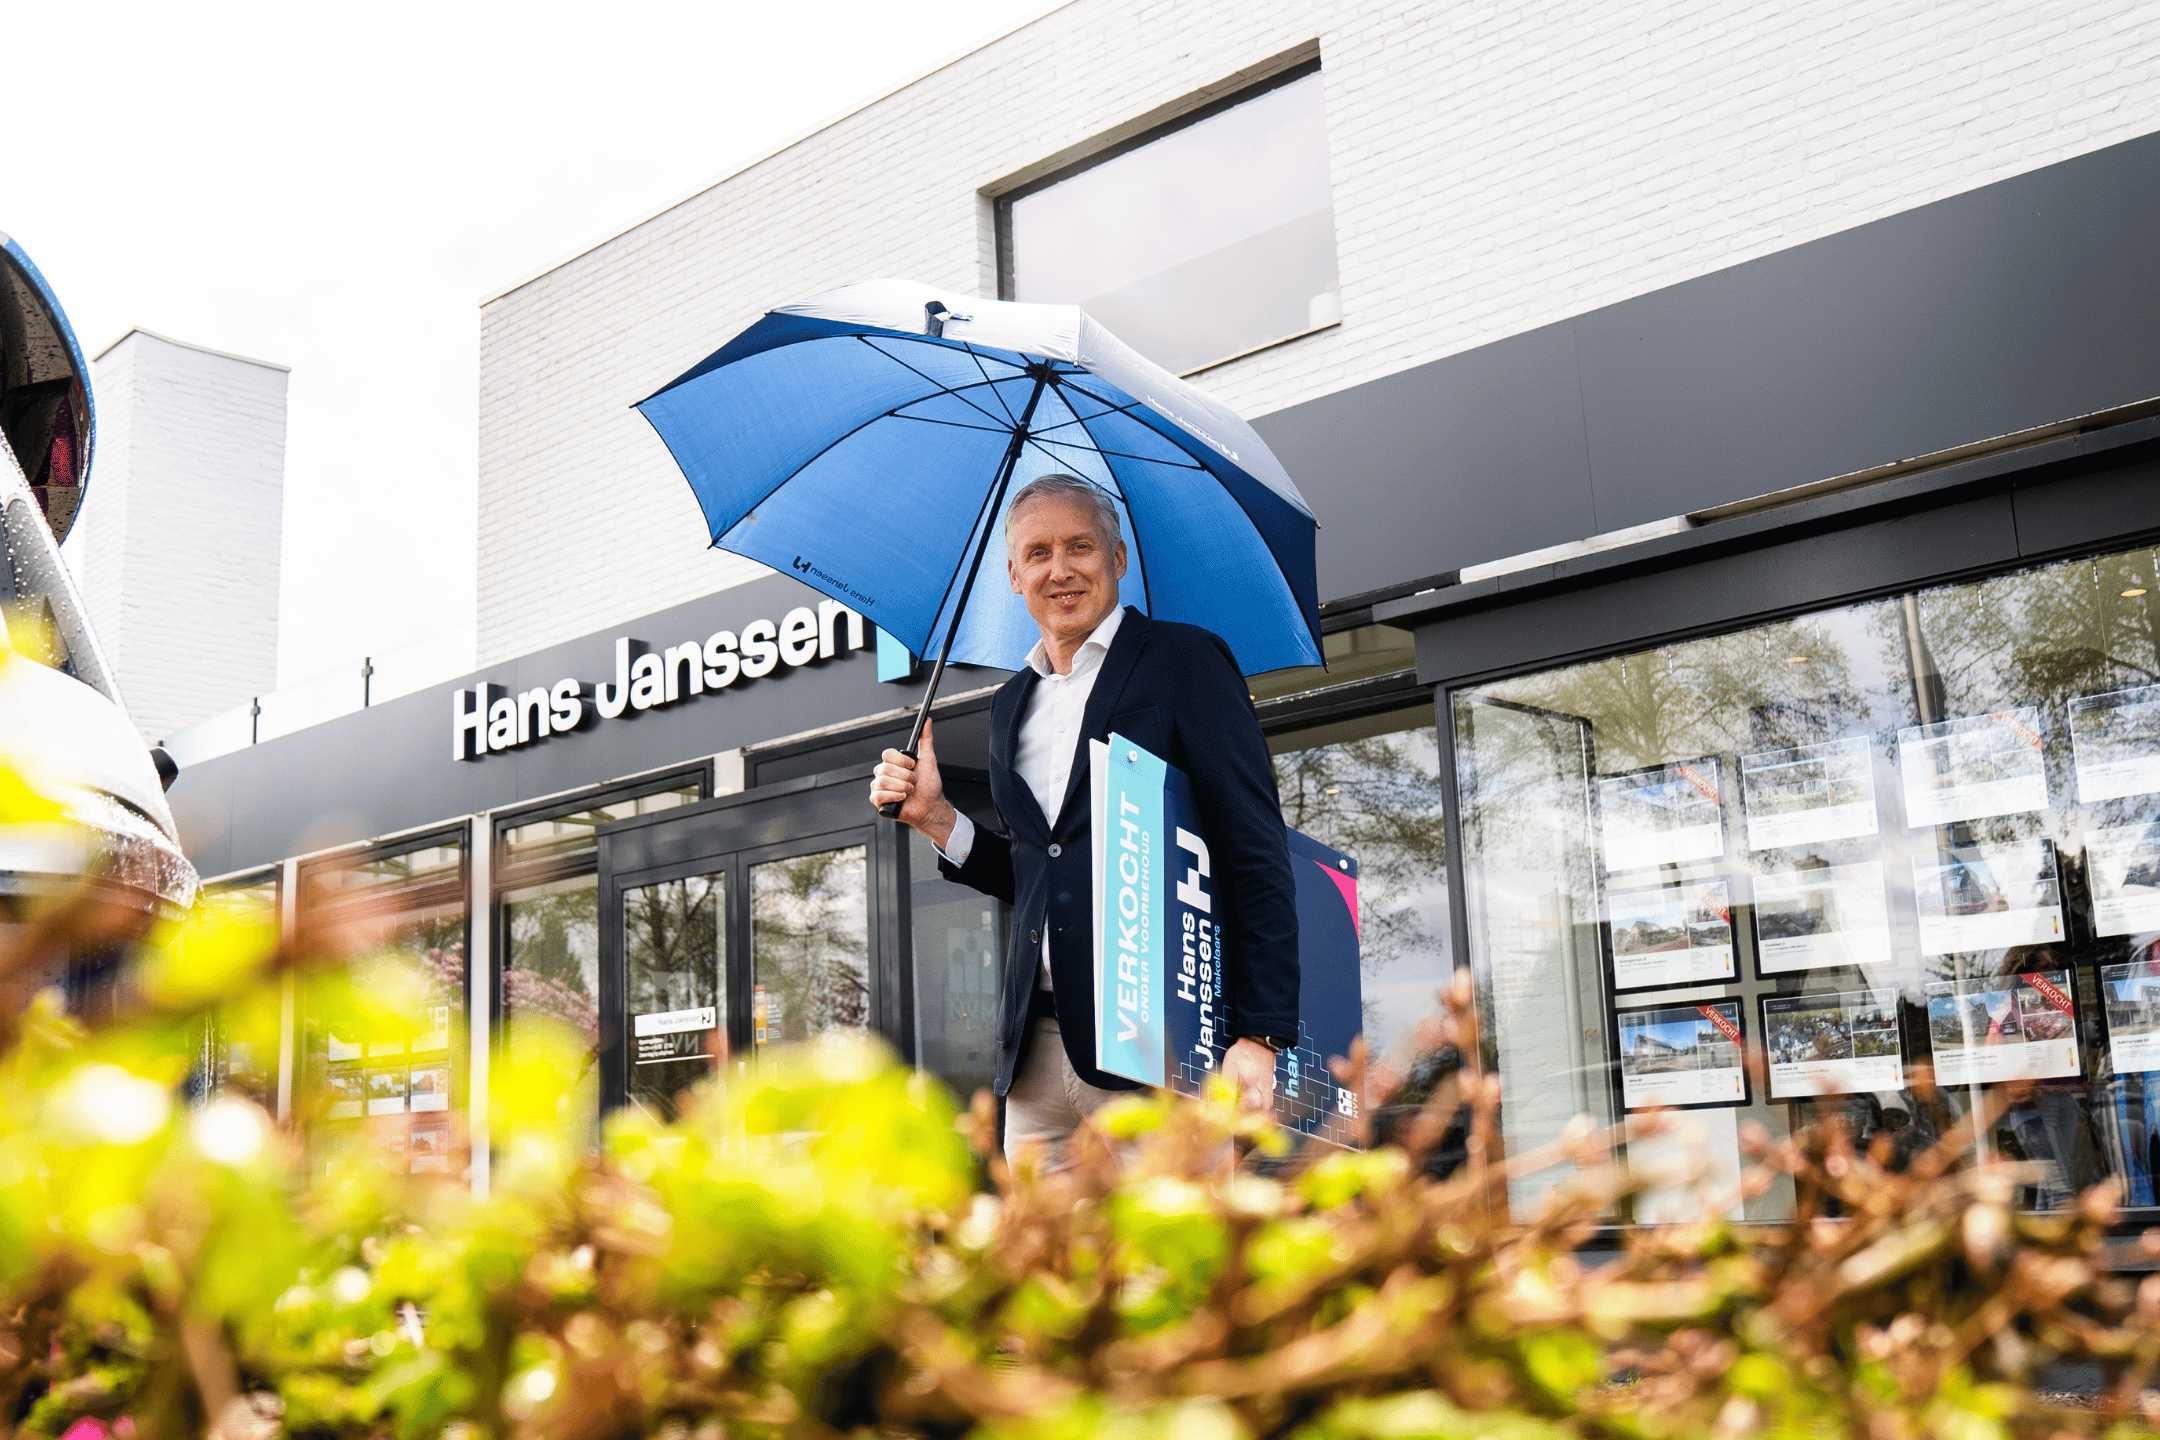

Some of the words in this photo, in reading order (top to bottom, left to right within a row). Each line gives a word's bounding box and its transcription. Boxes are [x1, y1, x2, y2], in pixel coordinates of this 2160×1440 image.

[453, 677, 582, 762] Hans
[595, 598, 864, 720] Janssen
[2001, 713, 2039, 745] VERKOCHT
[1685, 767, 1717, 798] VERKOCHT
[1117, 791, 1140, 1043] VERKOCHT
[1140, 830, 1150, 958] VOORBEHOUD
[1177, 911, 1197, 1004] Hans
[1214, 924, 1222, 998] Makelaars
[2031, 973, 2073, 1010] VERKOCHT
[1140, 961, 1150, 1024] ONDER
[1194, 918, 1214, 1071] Janssen
[1705, 1006, 1739, 1039] VERKOCHT
[1351, 1093, 1359, 1119] NVM
